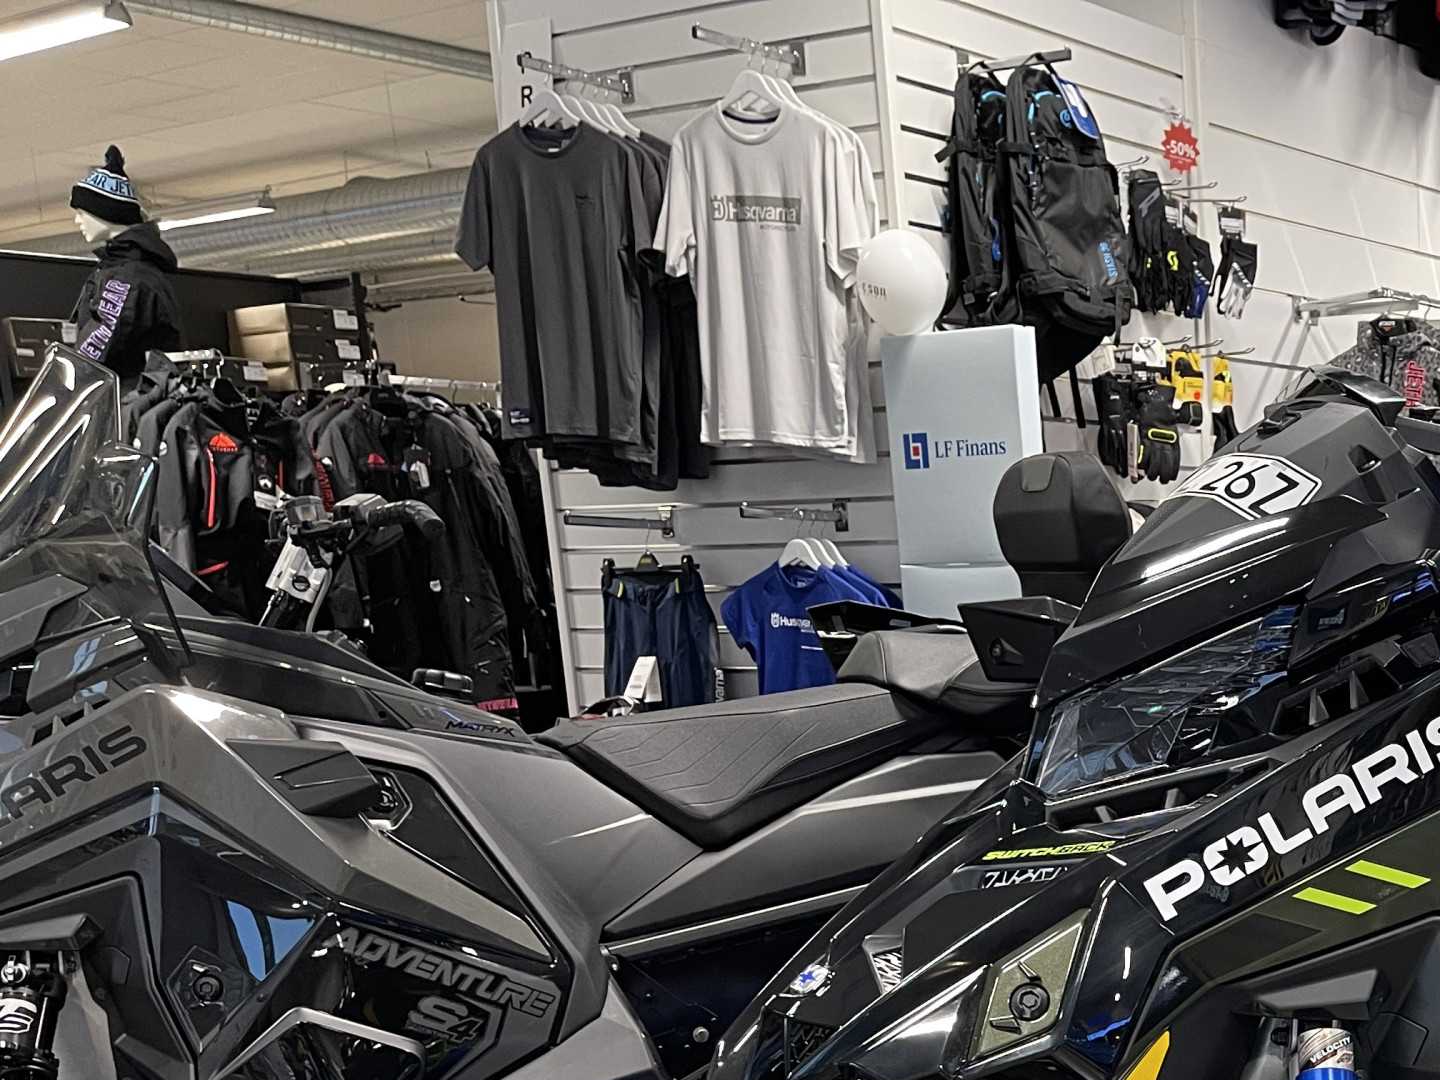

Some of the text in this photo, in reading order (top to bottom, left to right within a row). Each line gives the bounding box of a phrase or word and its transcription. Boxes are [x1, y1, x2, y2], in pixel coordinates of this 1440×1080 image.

[1166, 140, 1196, 159] -50%
[934, 439, 1007, 459] LF Finans
[0, 725, 147, 827] ARIS
[322, 926, 557, 1019] ADVENTURE
[1309, 1036, 1351, 1064] VELOCITY
